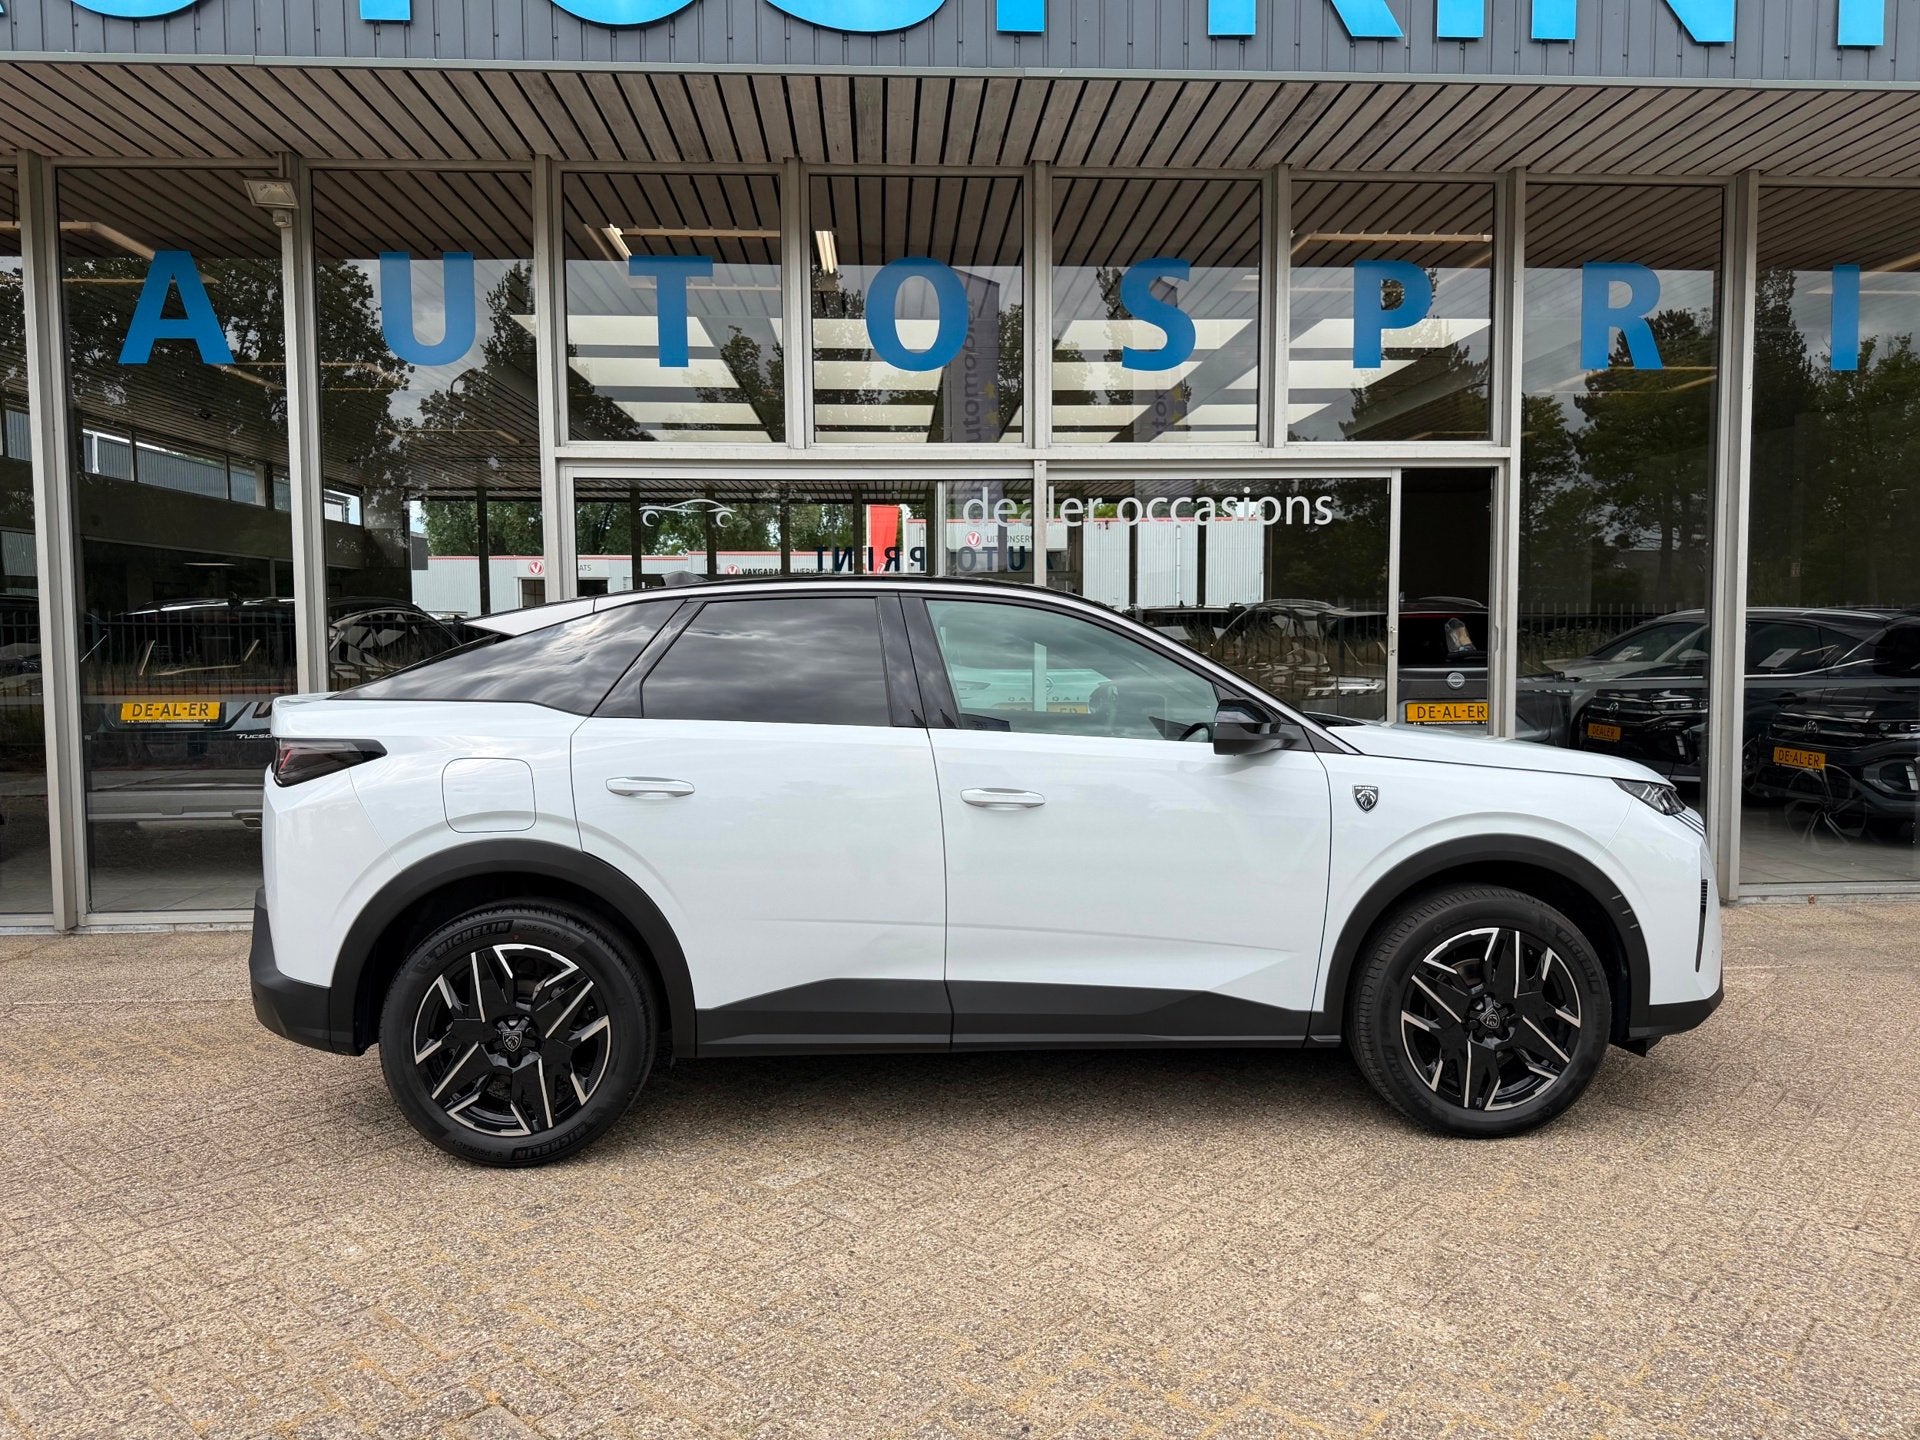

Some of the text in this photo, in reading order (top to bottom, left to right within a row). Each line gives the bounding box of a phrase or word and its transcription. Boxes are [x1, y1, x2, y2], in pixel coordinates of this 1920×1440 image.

[1117, 487, 1333, 527] occasions
[131, 703, 209, 717] DE-AL-ER
[1416, 705, 1485, 719] DE-AL-ER
[1777, 749, 1820, 767] DE-AL-ER
[433, 920, 511, 958] MICHELIN
